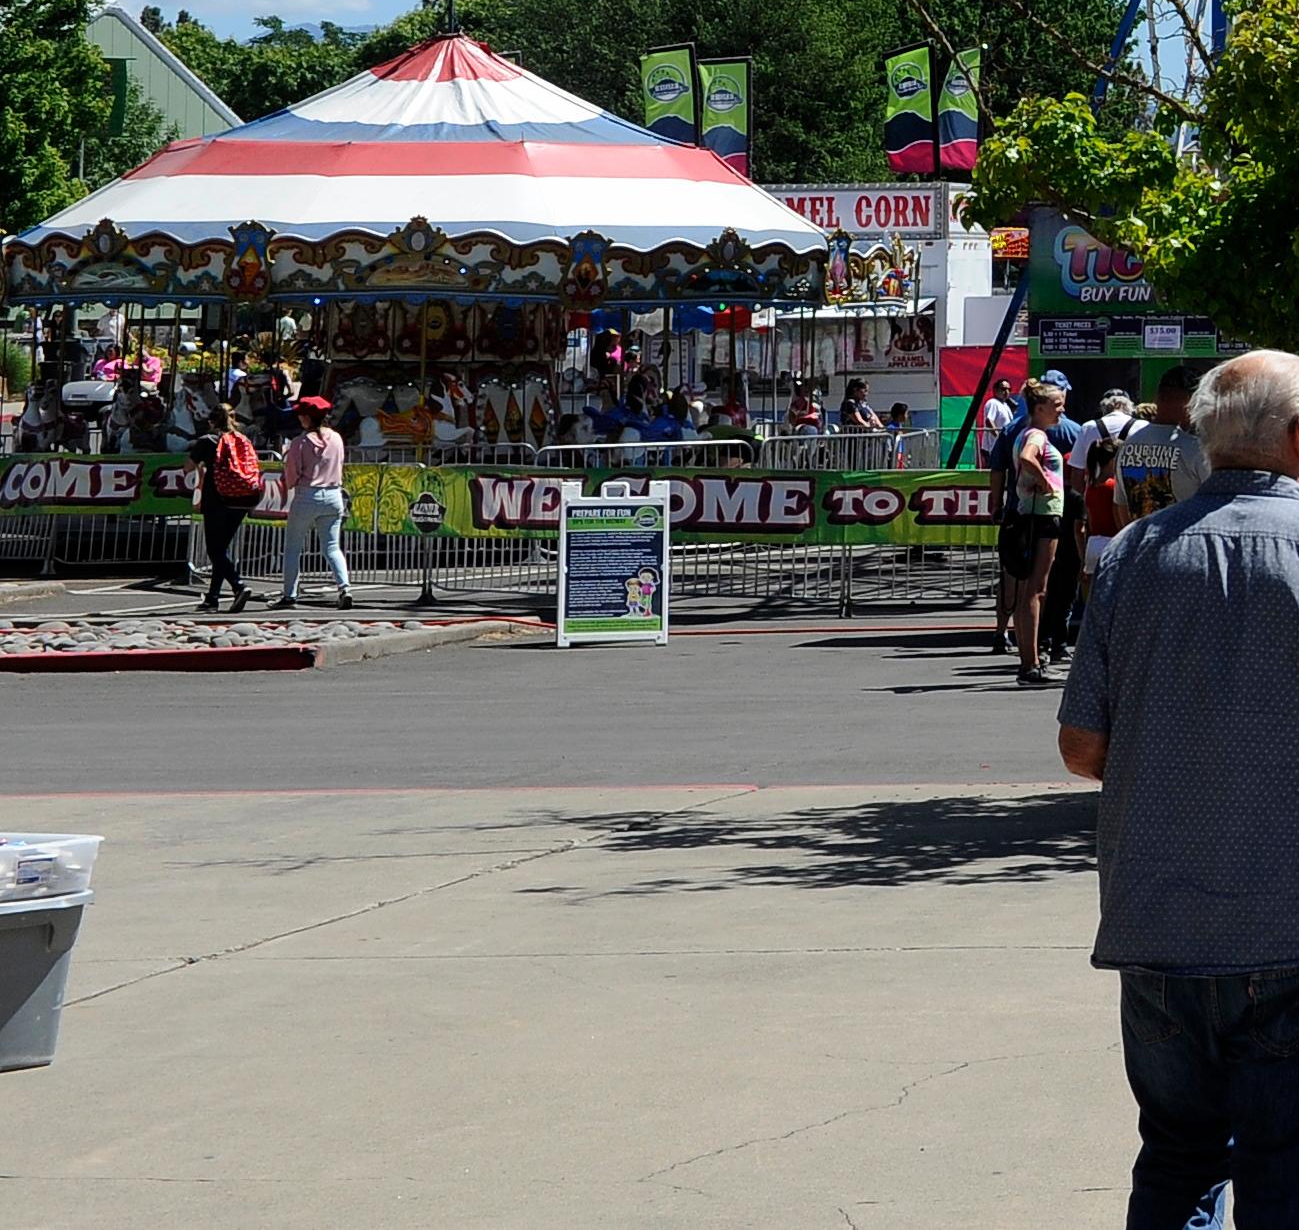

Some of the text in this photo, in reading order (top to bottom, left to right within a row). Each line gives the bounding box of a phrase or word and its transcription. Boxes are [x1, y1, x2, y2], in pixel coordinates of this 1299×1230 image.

[855, 195, 931, 228] CORN
[1080, 287, 1151, 302] BUY FUN
[1152, 445, 1181, 459] TIME
[1144, 456, 1177, 469] COME
[832, 489, 899, 516] TO
[572, 509, 631, 517] PREPARE FOR FUN
